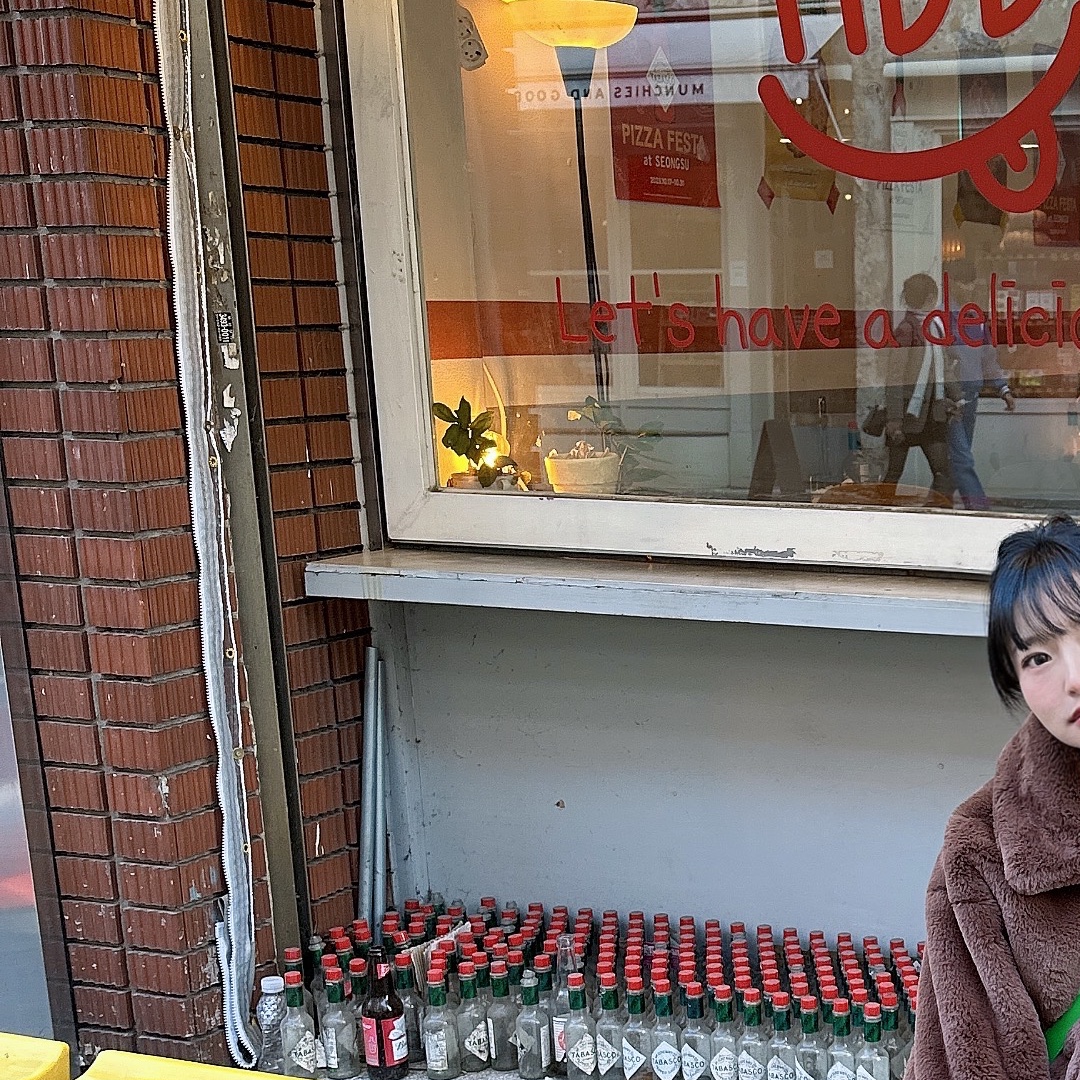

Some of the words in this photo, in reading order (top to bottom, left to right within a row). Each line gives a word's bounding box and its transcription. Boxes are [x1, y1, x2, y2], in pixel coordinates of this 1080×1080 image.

[621, 123, 664, 150] PIZZA
[643, 154, 653, 167] at
[655, 155, 690, 171] SEONGSU
[555, 271, 695, 348] Let's
[714, 274, 840, 349] have
[864, 308, 898, 348] a
